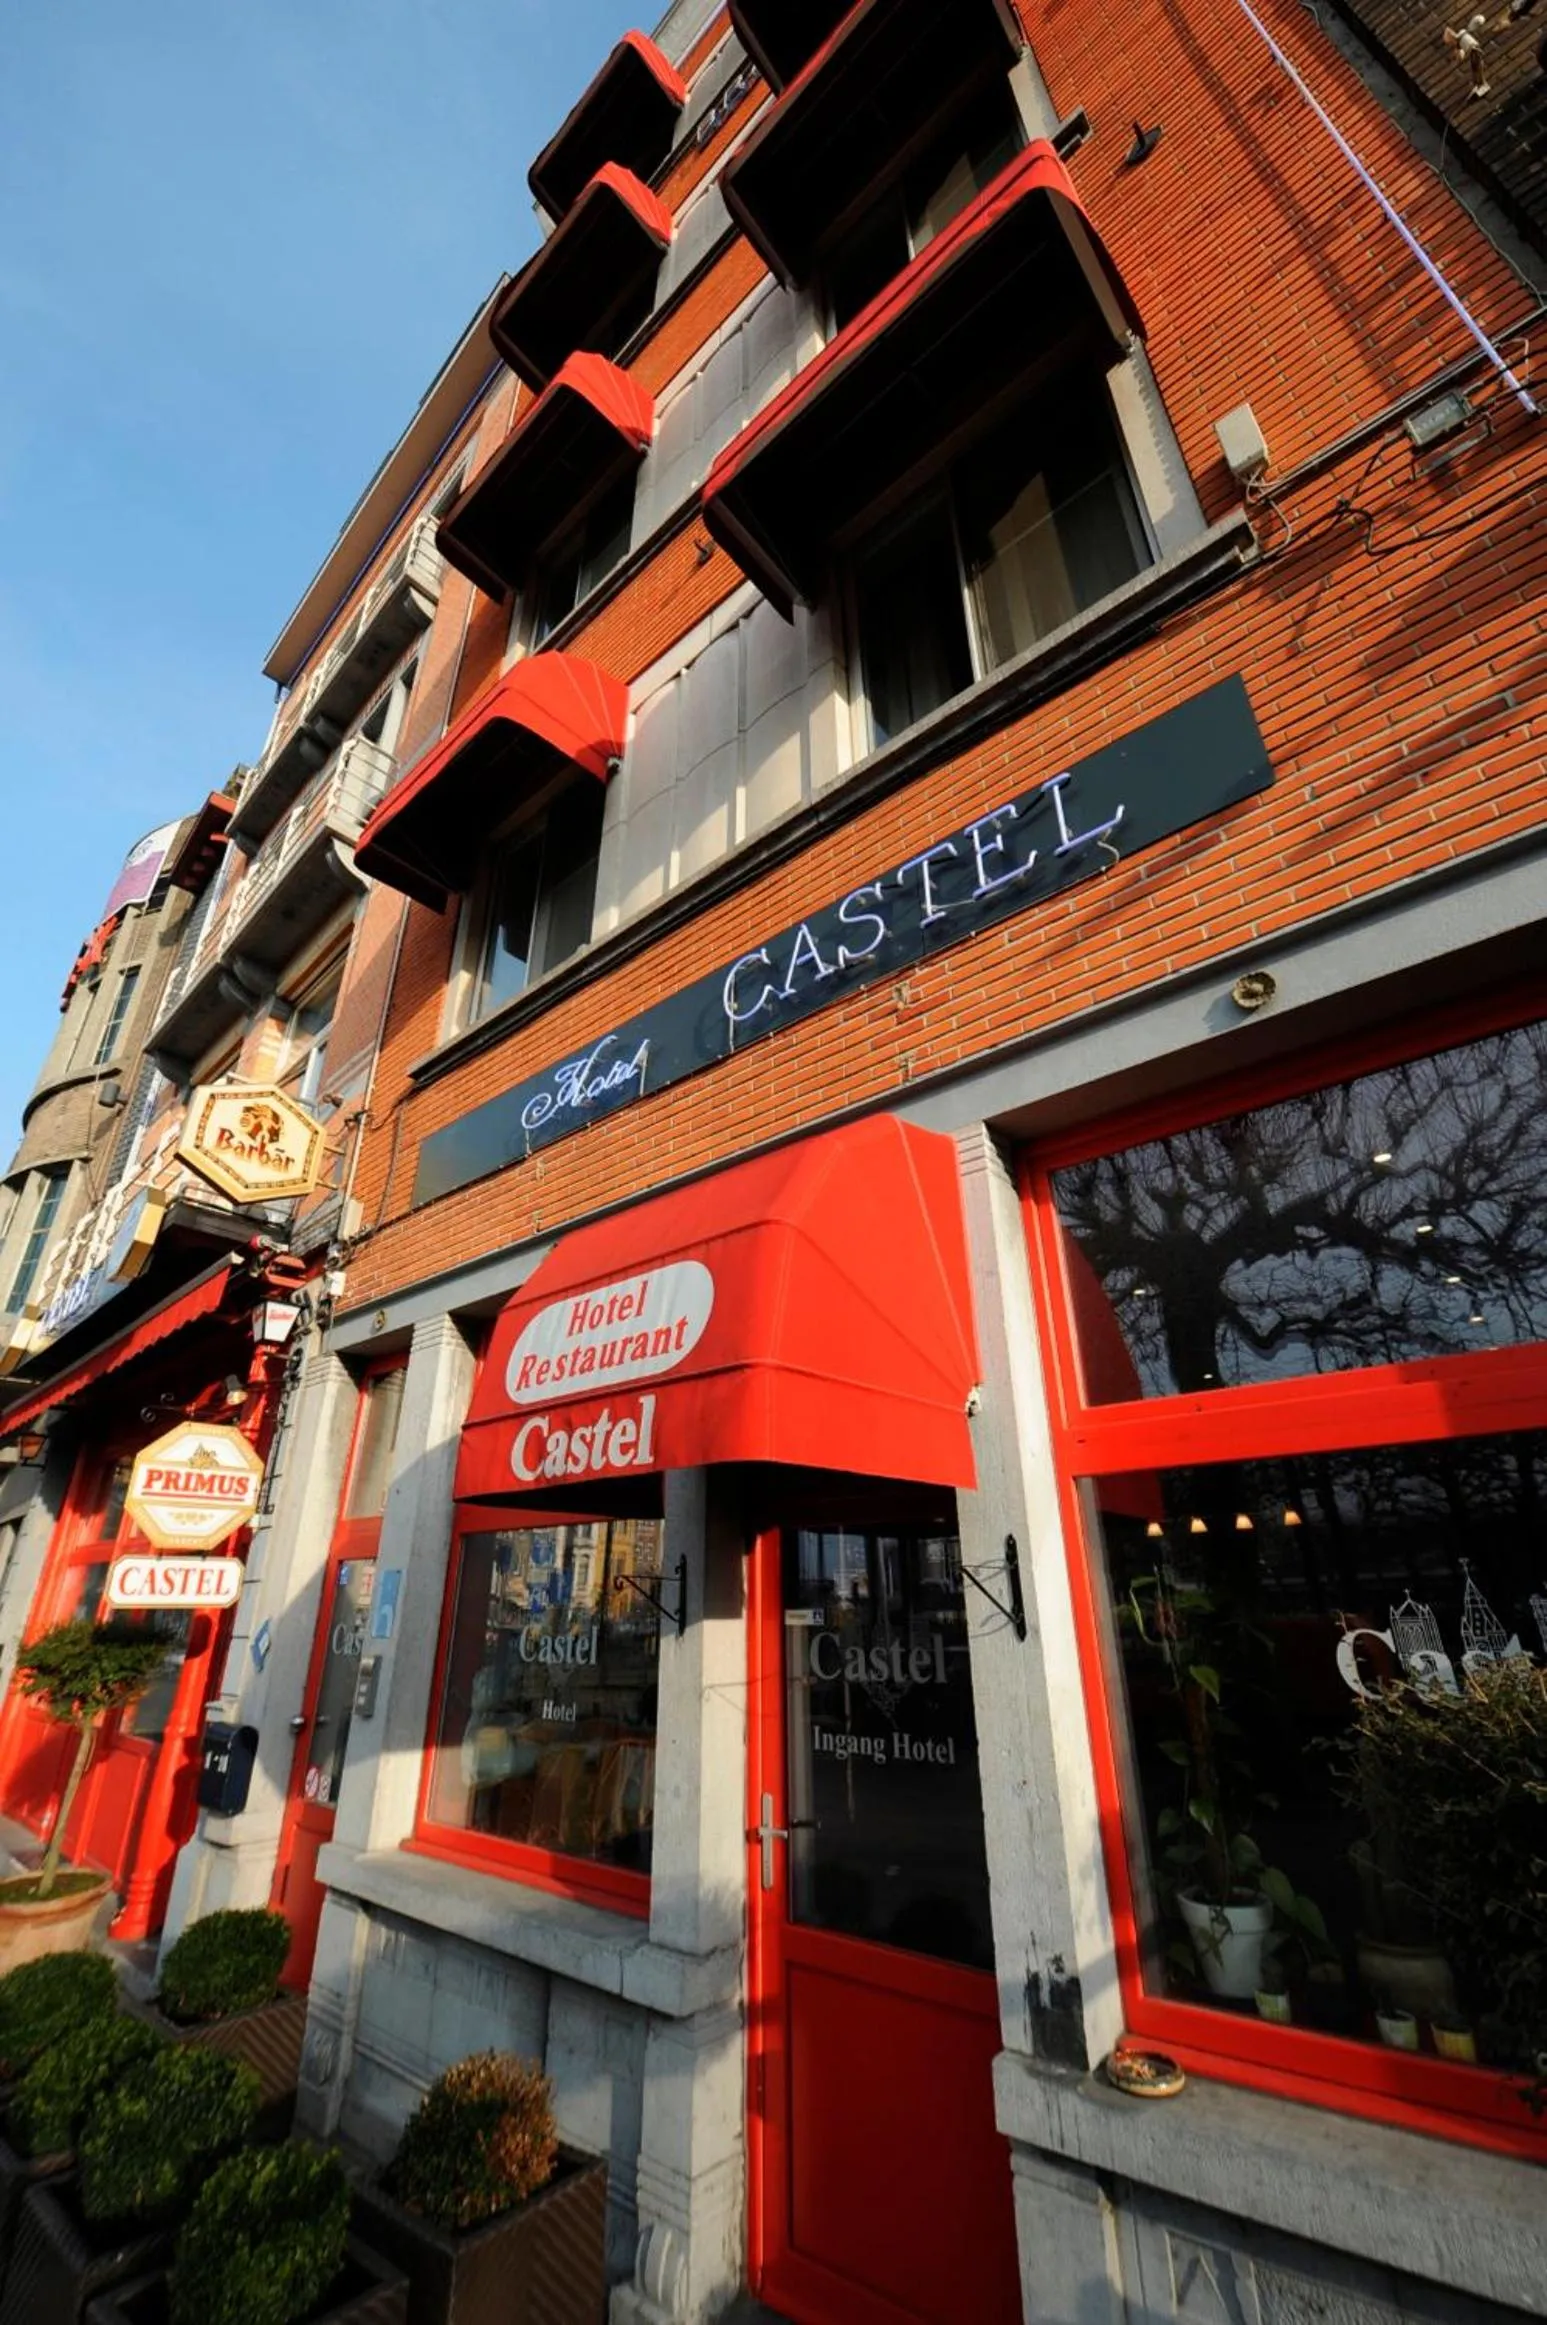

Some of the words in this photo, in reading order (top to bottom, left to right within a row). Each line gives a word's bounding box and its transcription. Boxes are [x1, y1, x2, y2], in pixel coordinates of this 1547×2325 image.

[723, 772, 1125, 1020] CASTEL
[567, 1280, 649, 1338] Hotel
[515, 1315, 688, 1392] Restaurant
[511, 1393, 656, 1481] Castel
[143, 1468, 249, 1496] PRIMUS
[118, 1566, 232, 1597] CASTEL
[519, 1624, 598, 1665] Castel
[810, 1631, 948, 1684] Castel
[541, 1699, 577, 1721] Hotel
[813, 1724, 887, 1764] Ingang
[892, 1731, 956, 1764] Hotel
